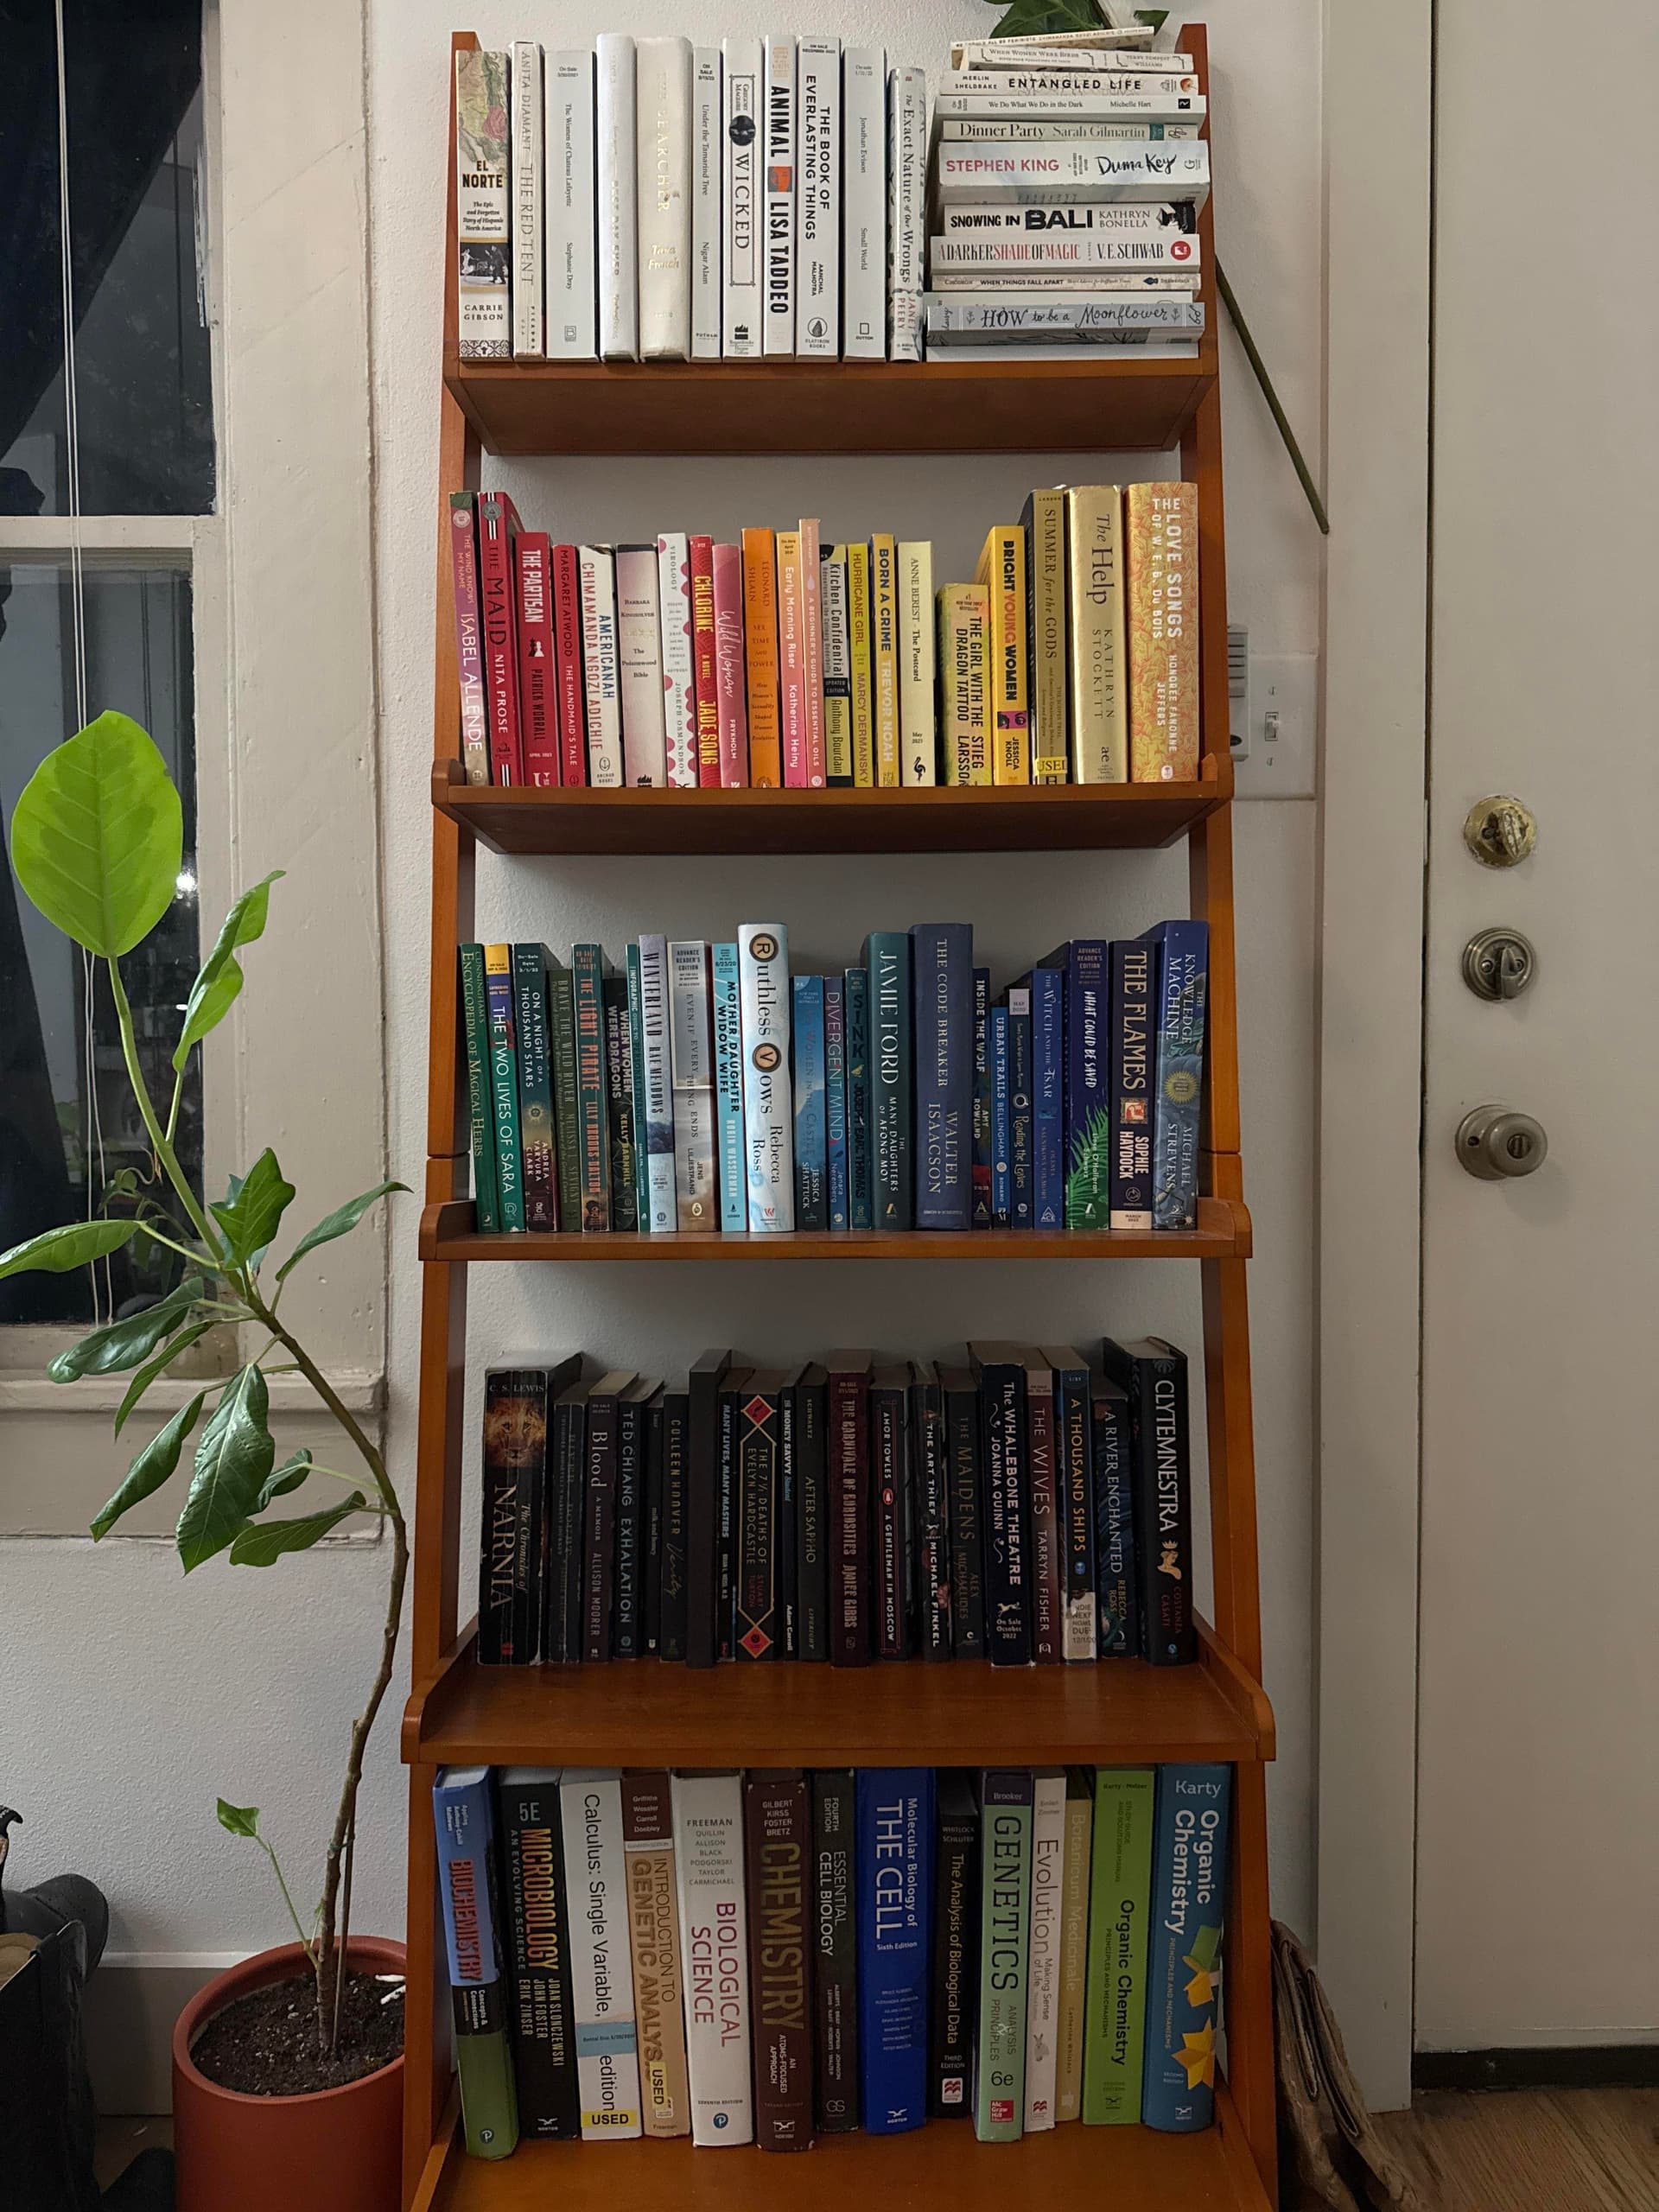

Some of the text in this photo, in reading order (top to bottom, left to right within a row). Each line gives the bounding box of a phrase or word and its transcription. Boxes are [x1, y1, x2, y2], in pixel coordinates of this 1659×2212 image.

[771, 86, 789, 157] ANIMAL
[1008, 79, 1141, 90] ENTANGLED LIFE
[477, 161, 489, 170] EL
[806, 75, 816, 239] EVERLASTING THINGS
[820, 106, 830, 209] THE BOOK OF
[946, 160, 1016, 171] STEPHEN
[1021, 160, 1058, 171] KING
[960, 124, 1045, 139] Dinner Party
[462, 174, 503, 188] NORTE
[520, 163, 533, 285] THE RED TENT
[735, 154, 749, 249] WICKED
[771, 202, 789, 239] LISA
[950, 209, 1092, 231] SNOWING IN BALI
[771, 246, 788, 314] TADDEO
[522, 550, 543, 622] THE PARTISAN
[748, 567, 757, 602] SHLAIN
[784, 567, 794, 594] Early
[880, 549, 891, 651] BORN A CRIME
[1087, 515, 1114, 604] The Help
[1168, 514, 1182, 638] LOVE SONGS
[486, 545, 507, 734] THE MAID NITA PROSE
[582, 563, 602, 749] CHIMAMANDA NGOZI ADICHIE
[600, 615, 613, 698] AMERICANAH
[785, 598, 796, 639] Morning
[830, 563, 844, 676] Kitchen Confidential
[461, 613, 482, 752] ISABEL ALLENDE
[567, 684, 575, 741] HANDMAID'S
[790, 684, 798, 734] Katherine
[790, 740, 799, 767] Heiny
[832, 700, 844, 773] Anthony Bourdain
[643, 953, 663, 1037] WINTERLAND
[880, 950, 899, 1084] JAMIE FORD
[937, 940, 948, 1087] THE CODE BREAKER
[996, 1017, 1005, 1055] URBAN
[1122, 950, 1147, 1090] THE FLAMES
[719, 1005, 728, 1093] WIDOW WIFE
[728, 982, 740, 1112] MOTHER DAUGHTER
[493, 1007, 514, 1193] THE TWO LIVES OF SARA
[928, 1103, 940, 1193] ISAACSON
[945, 1112, 958, 1185] WALTER
[1120, 1131, 1135, 1179] HAYDOCK
[1134, 1136, 1149, 1174] SOPHIE
[1166, 1123, 1177, 1189] STREVENS
[1182, 1127, 1192, 1187] MICHAEL
[591, 1431, 607, 1487] Blood
[991, 1436, 1003, 1529] JOANNA QUINN
[1003, 1382, 1021, 1585] The WHALEBONE THEATRE
[1071, 1399, 1085, 1551] A THOUSAND SHIPS
[1155, 1380, 1177, 1531] CLYTEMNESTRA
[491, 1484, 516, 1610] NARNIA
[620, 1410, 634, 1623] TED CHIANG EXHALATION
[1033, 1408, 1050, 1630] THE WIVES TARRYN FISHER
[1175, 1780, 1222, 1799] Karty
[520, 1828, 559, 1970] MICROBIOLOGY
[834, 1851, 846, 1926] ESSENTIAL
[875, 1799, 902, 1939] THE CELL
[905, 1798, 918, 1927] Molecular Biology of
[1033, 1840, 1058, 1953] Evolution
[1166, 1810, 1194, 1935] Chemistry
[1193, 1810, 1218, 1904] Organic
[449, 1859, 483, 1981] BIOCHEMISTRY
[584, 1795, 611, 2018] Calculus: Single Variable,
[760, 1843, 804, 2029] CHEMISTRY
[819, 1852, 834, 1955] CELL BIOLOGY
[946, 1853, 964, 2044] The Analysis of Biological Data
[992, 1816, 1021, 1990] GENETICS
[1116, 1899, 1135, 1968] Organic
[534, 1979, 548, 2038] JOHN FOSTER
[691, 1927, 713, 2024] SCIENCE
[716, 1904, 741, 2046] BIOLOGICAL
[1112, 1975, 1133, 2065] Chemistry
[591, 2115, 629, 2125] USED
[991, 2071, 1014, 2087] 6e
